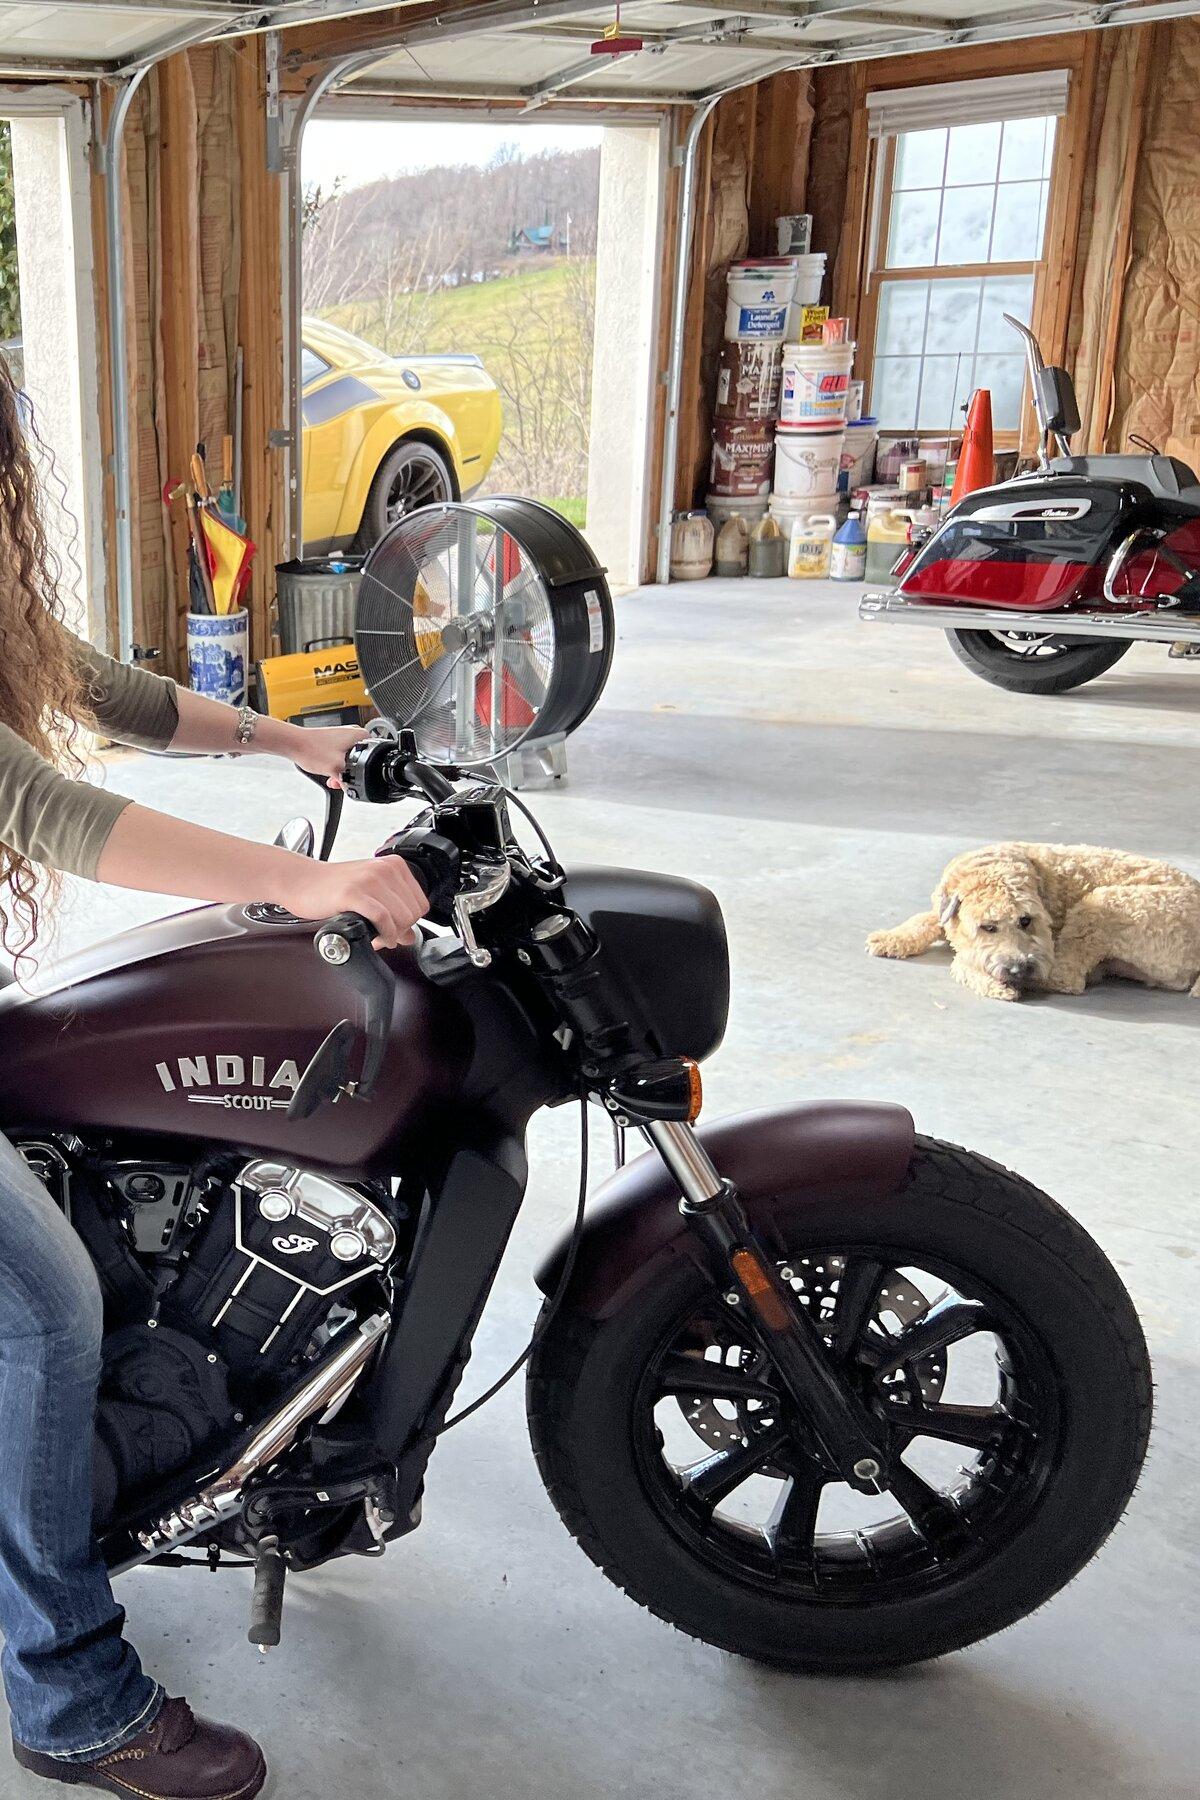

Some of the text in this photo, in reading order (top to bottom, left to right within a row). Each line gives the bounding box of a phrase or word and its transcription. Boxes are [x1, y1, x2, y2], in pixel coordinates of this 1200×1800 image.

[725, 442, 774, 454] MAXIMUM
[314, 660, 359, 678] MAS
[155, 1055, 300, 1092] INDIA
[224, 1094, 274, 1111] SCOUT
